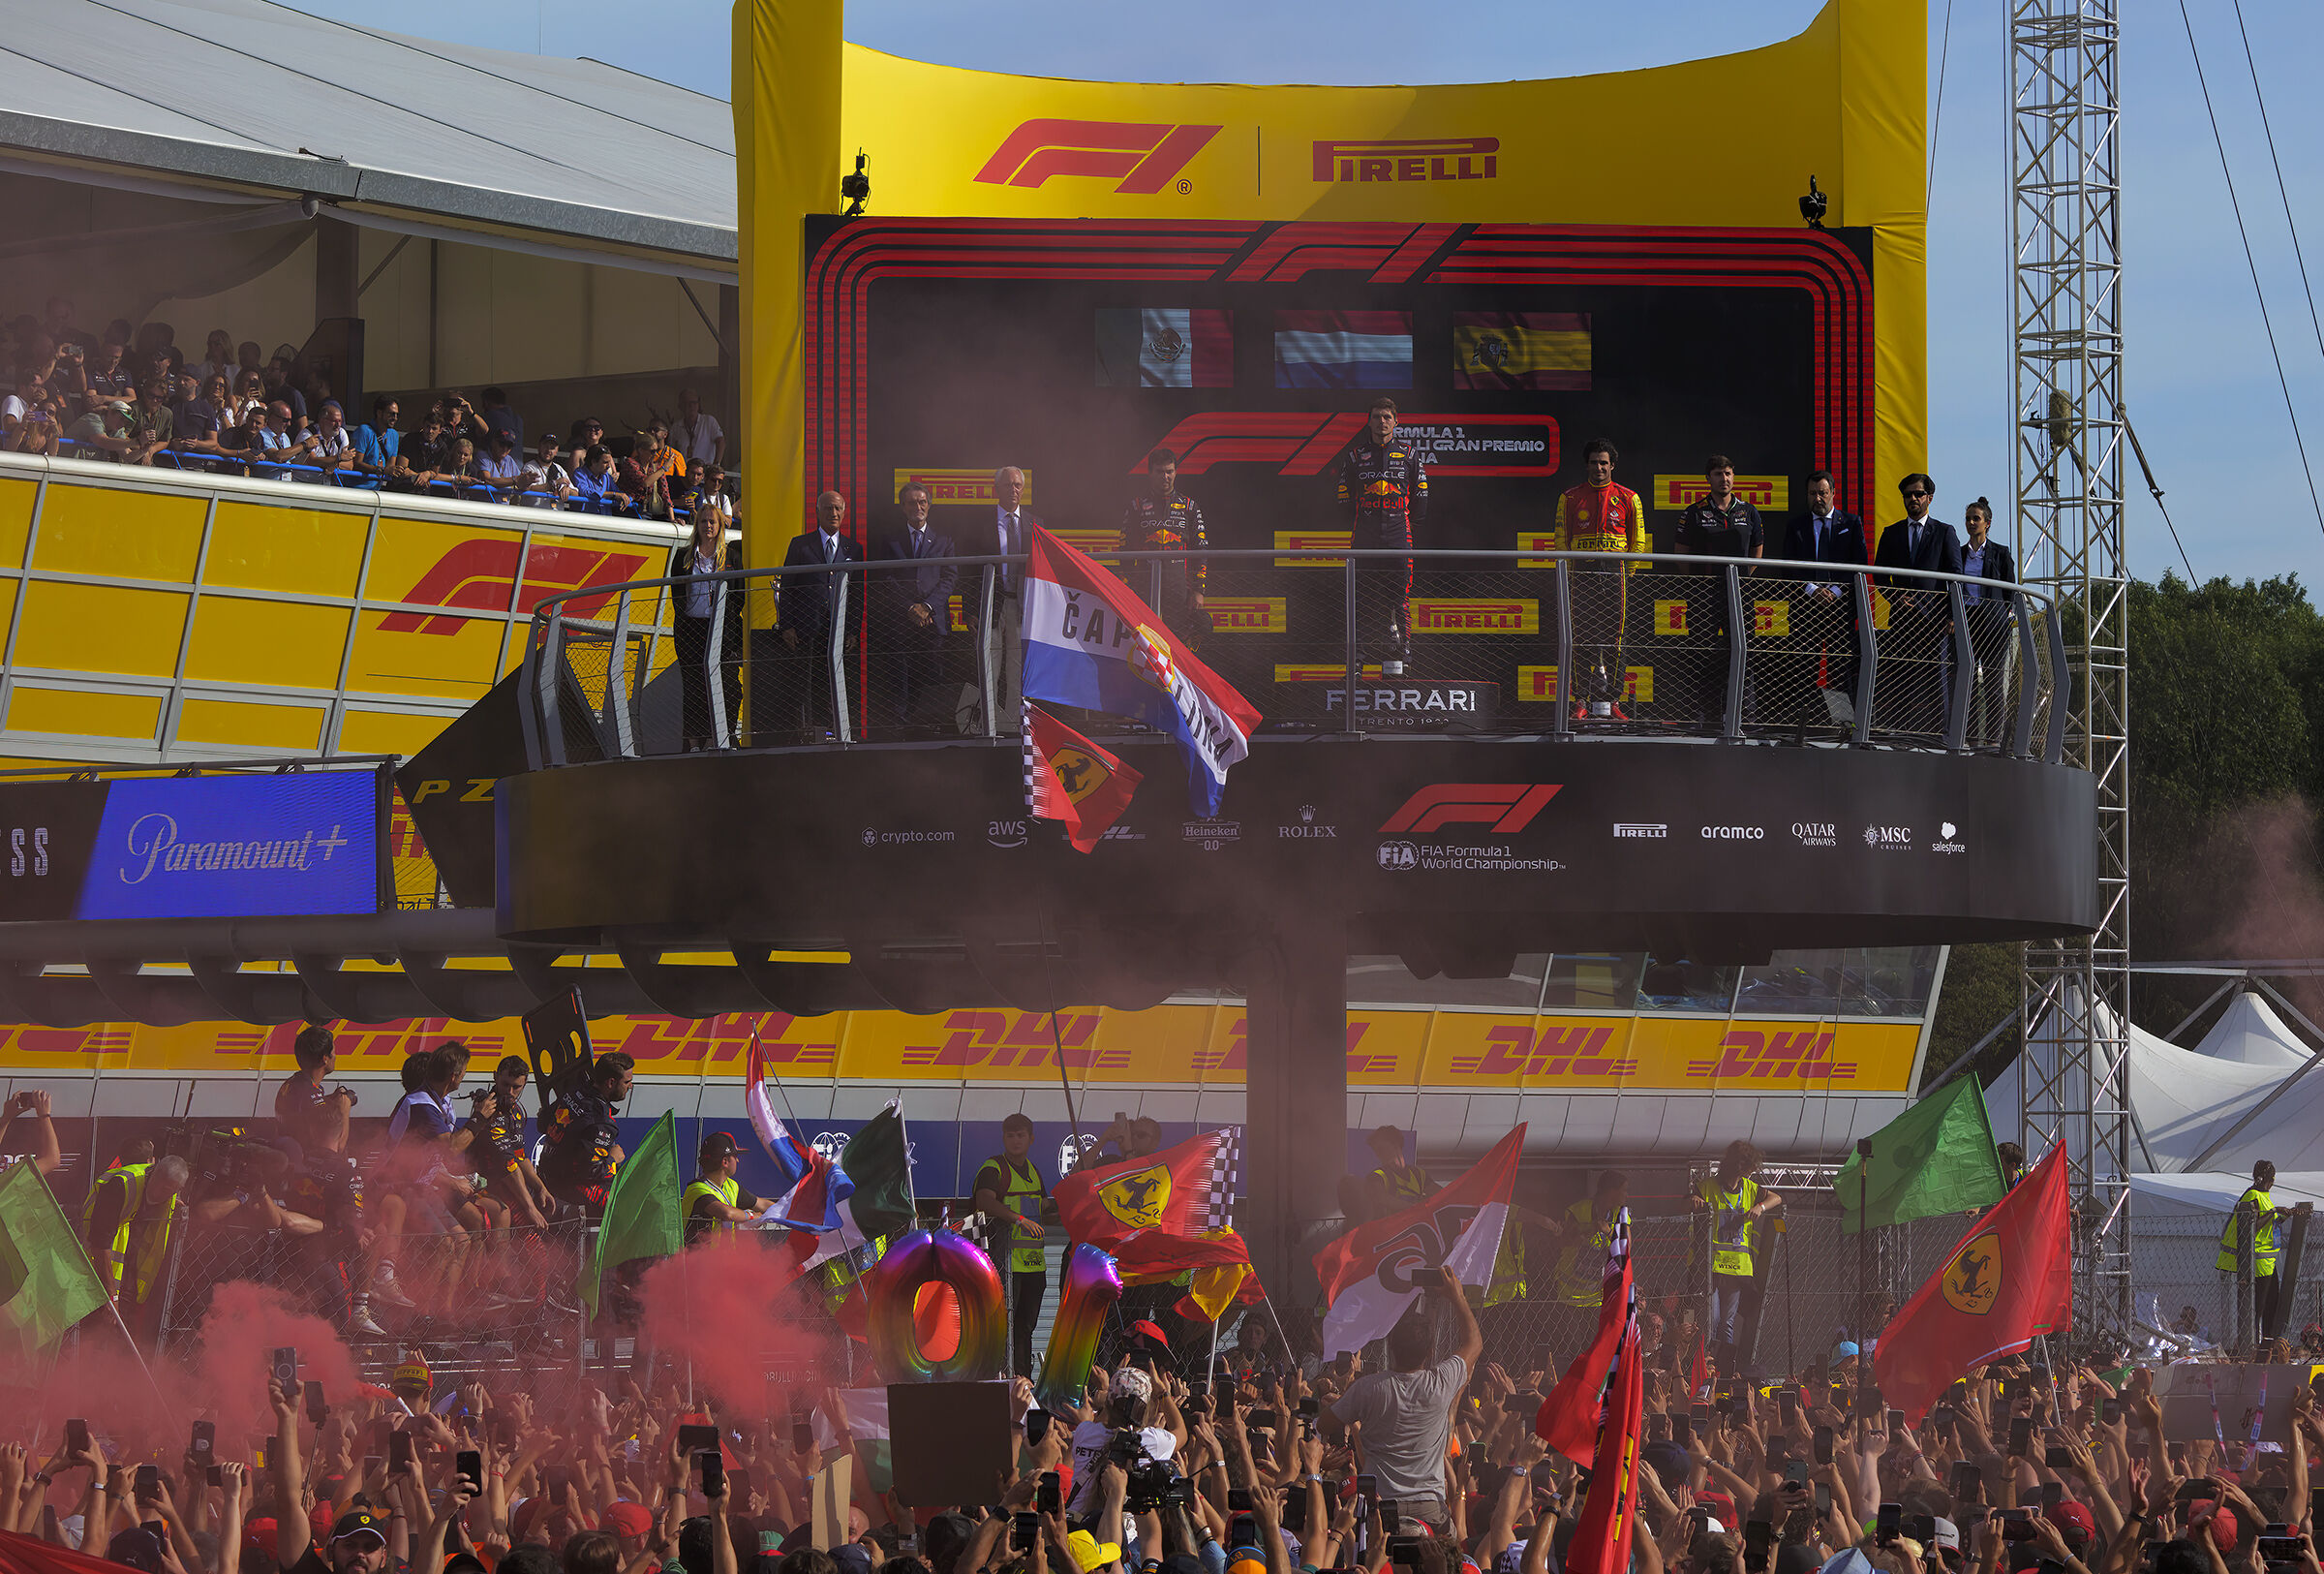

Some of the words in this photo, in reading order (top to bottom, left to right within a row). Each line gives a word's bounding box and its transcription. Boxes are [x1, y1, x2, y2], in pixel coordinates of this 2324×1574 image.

[1312, 137, 1500, 182] PIRELLI
[1393, 426, 1453, 438] RMULA
[1456, 426, 1465, 438] 1
[1433, 440, 1480, 451] GRAN
[1483, 440, 1545, 451] PREMIO
[1359, 471, 1405, 479] ORACLE
[1141, 519, 1186, 529] ORACLE
[1204, 603, 1270, 627] ELLI
[1419, 604, 1523, 628] PIRELLI
[1326, 690, 1477, 712] FERRARI
[988, 820, 1026, 836] aws
[1185, 826, 1238, 837] Heineken
[1278, 826, 1337, 838] ROLEX
[1613, 823, 1667, 838] PIRELLI
[1701, 825, 1764, 840] aramco
[1791, 822, 1836, 838] QATAR
[1881, 826, 1911, 844] MSC
[881, 829, 955, 845] crypto.com
[1803, 838, 1836, 847] AIRWAYS
[119, 813, 348, 884] Paramount+
[1422, 846, 1443, 856] FIA
[1447, 846, 1501, 856] Formula
[1504, 846, 1512, 856] 1
[1932, 840, 1966, 855] salesforce
[1422, 858, 1463, 870] World
[1466, 858, 1557, 872] Championship
[620, 1012, 802, 1062] DHL
[933, 1011, 1103, 1067] DHL
[1476, 1025, 1615, 1076] DHL
[1709, 1031, 1835, 1079] DHL
[562, 1092, 585, 1117] ORACLE
